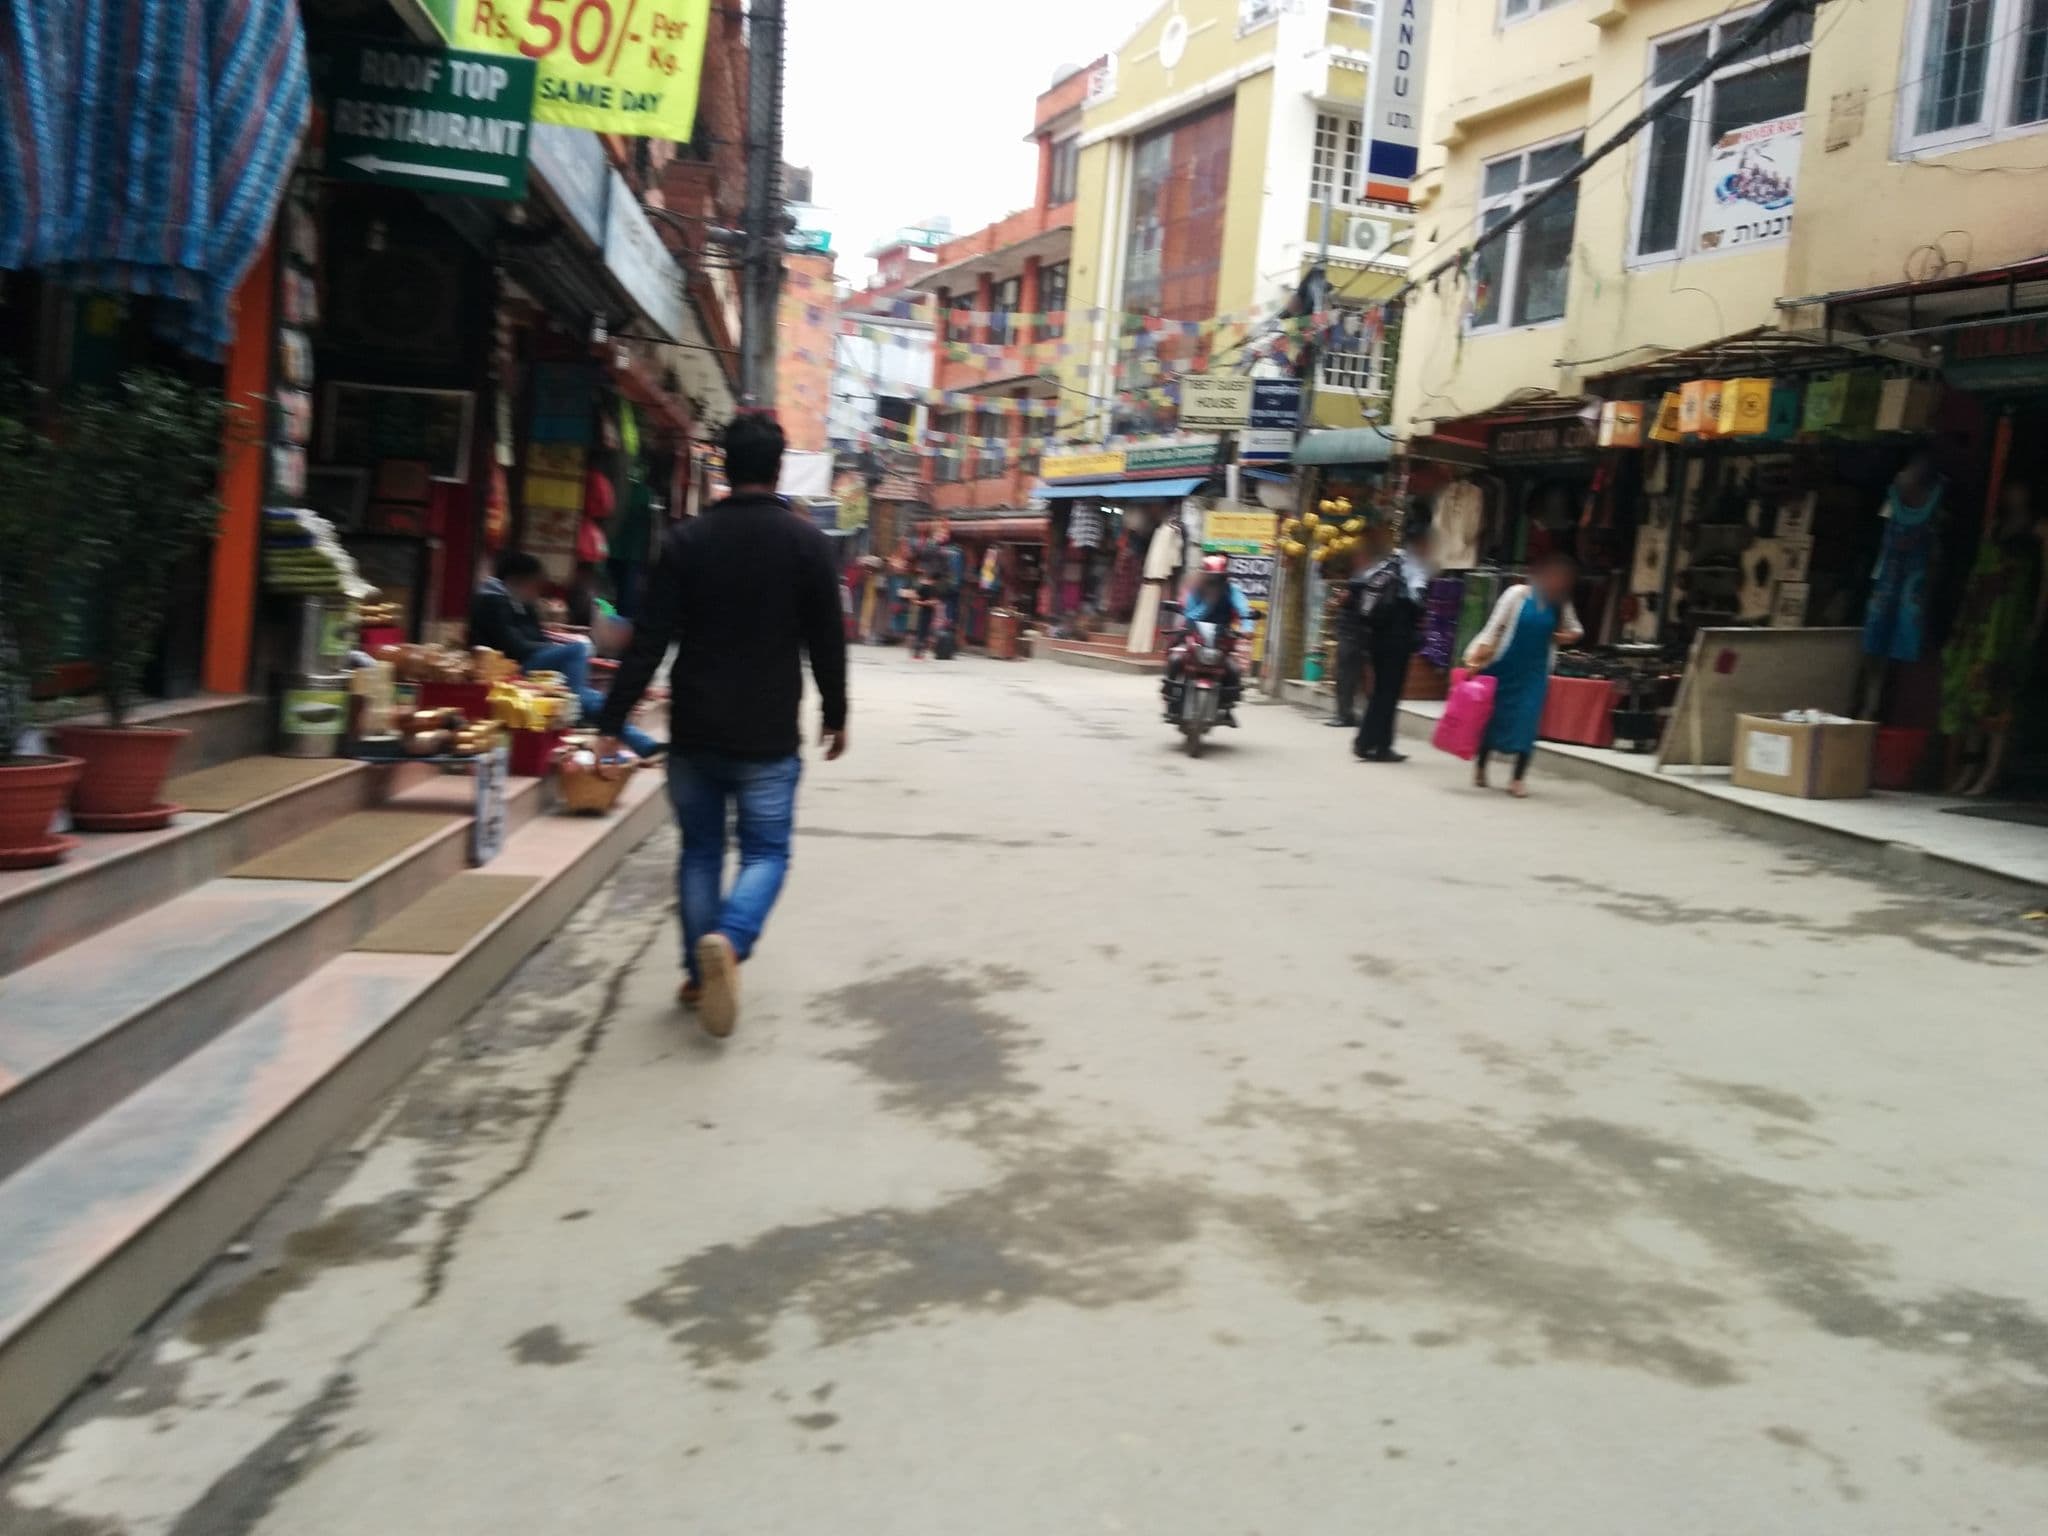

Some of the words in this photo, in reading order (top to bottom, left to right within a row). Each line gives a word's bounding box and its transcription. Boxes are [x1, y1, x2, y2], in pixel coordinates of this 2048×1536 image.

[652, 12, 690, 40] Per
[361, 49, 442, 93] ROOF
[448, 59, 509, 101] TOP
[540, 78, 613, 109] SAME
[621, 88, 663, 112] DAY
[335, 98, 526, 157] RESTAURANT
